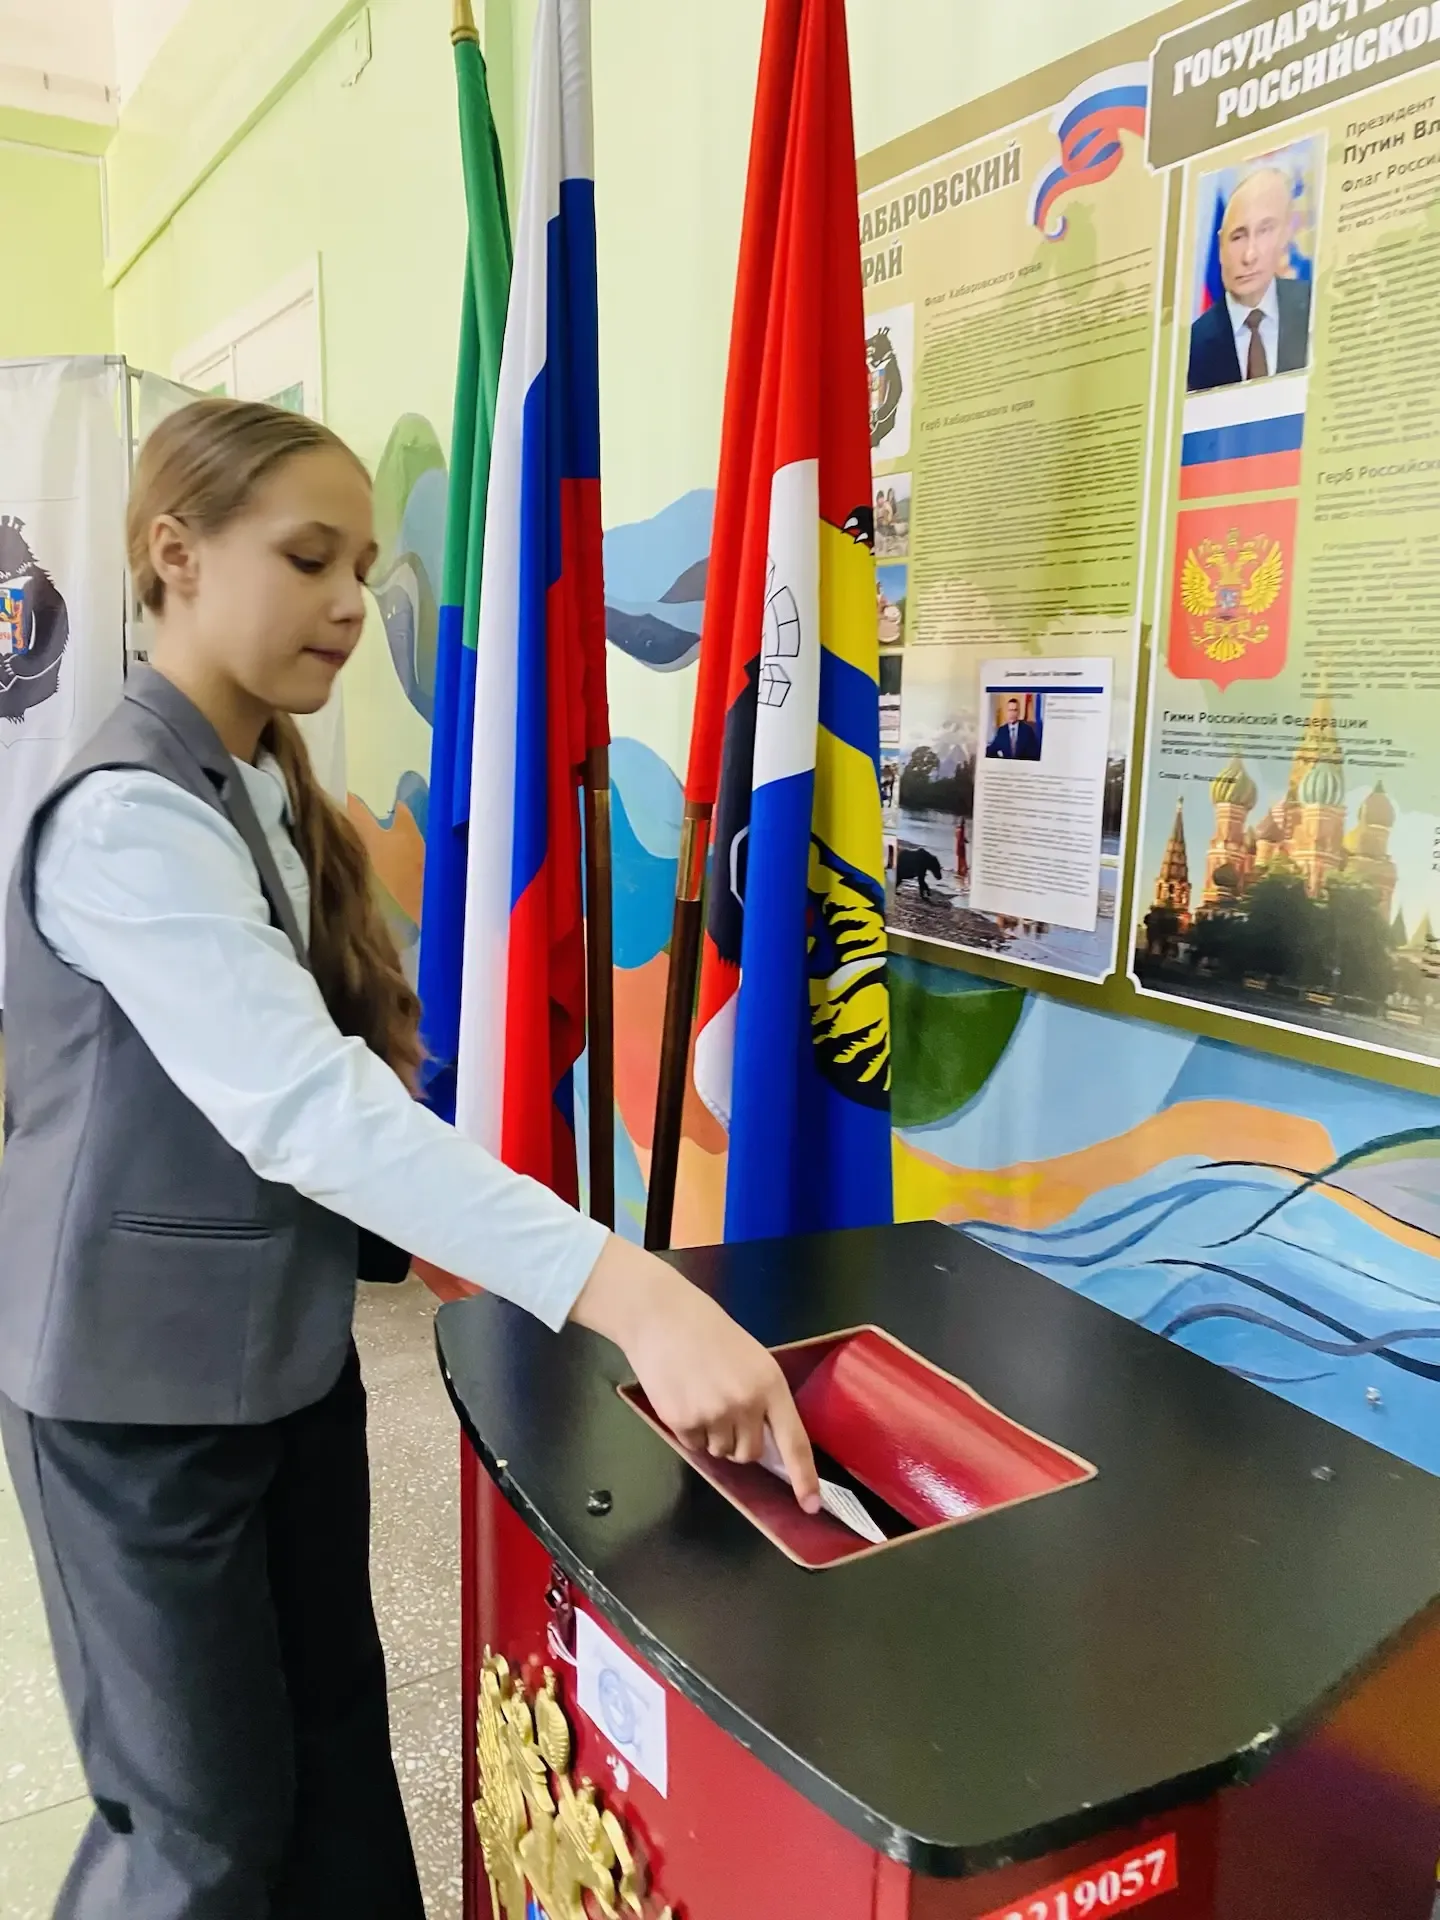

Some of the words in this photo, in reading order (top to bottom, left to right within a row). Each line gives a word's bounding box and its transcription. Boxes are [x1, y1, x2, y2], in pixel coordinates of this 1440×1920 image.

[1173, 0, 1388, 96] ГОСУДАРС
[1346, 96, 1436, 138] Президент
[1343, 131, 1405, 164] Путин
[861, 140, 1021, 243] АБАРОВСКИЙ
[1341, 170, 1382, 192] Флаг
[863, 240, 903, 288] РАЙ
[1317, 467, 1354, 485] Герб
[1163, 710, 1195, 723] Гимн
[1199, 711, 1278, 725] Российской
[1282, 714, 1368, 730] Федерации
[1003, 1848, 1167, 1920] 219057
